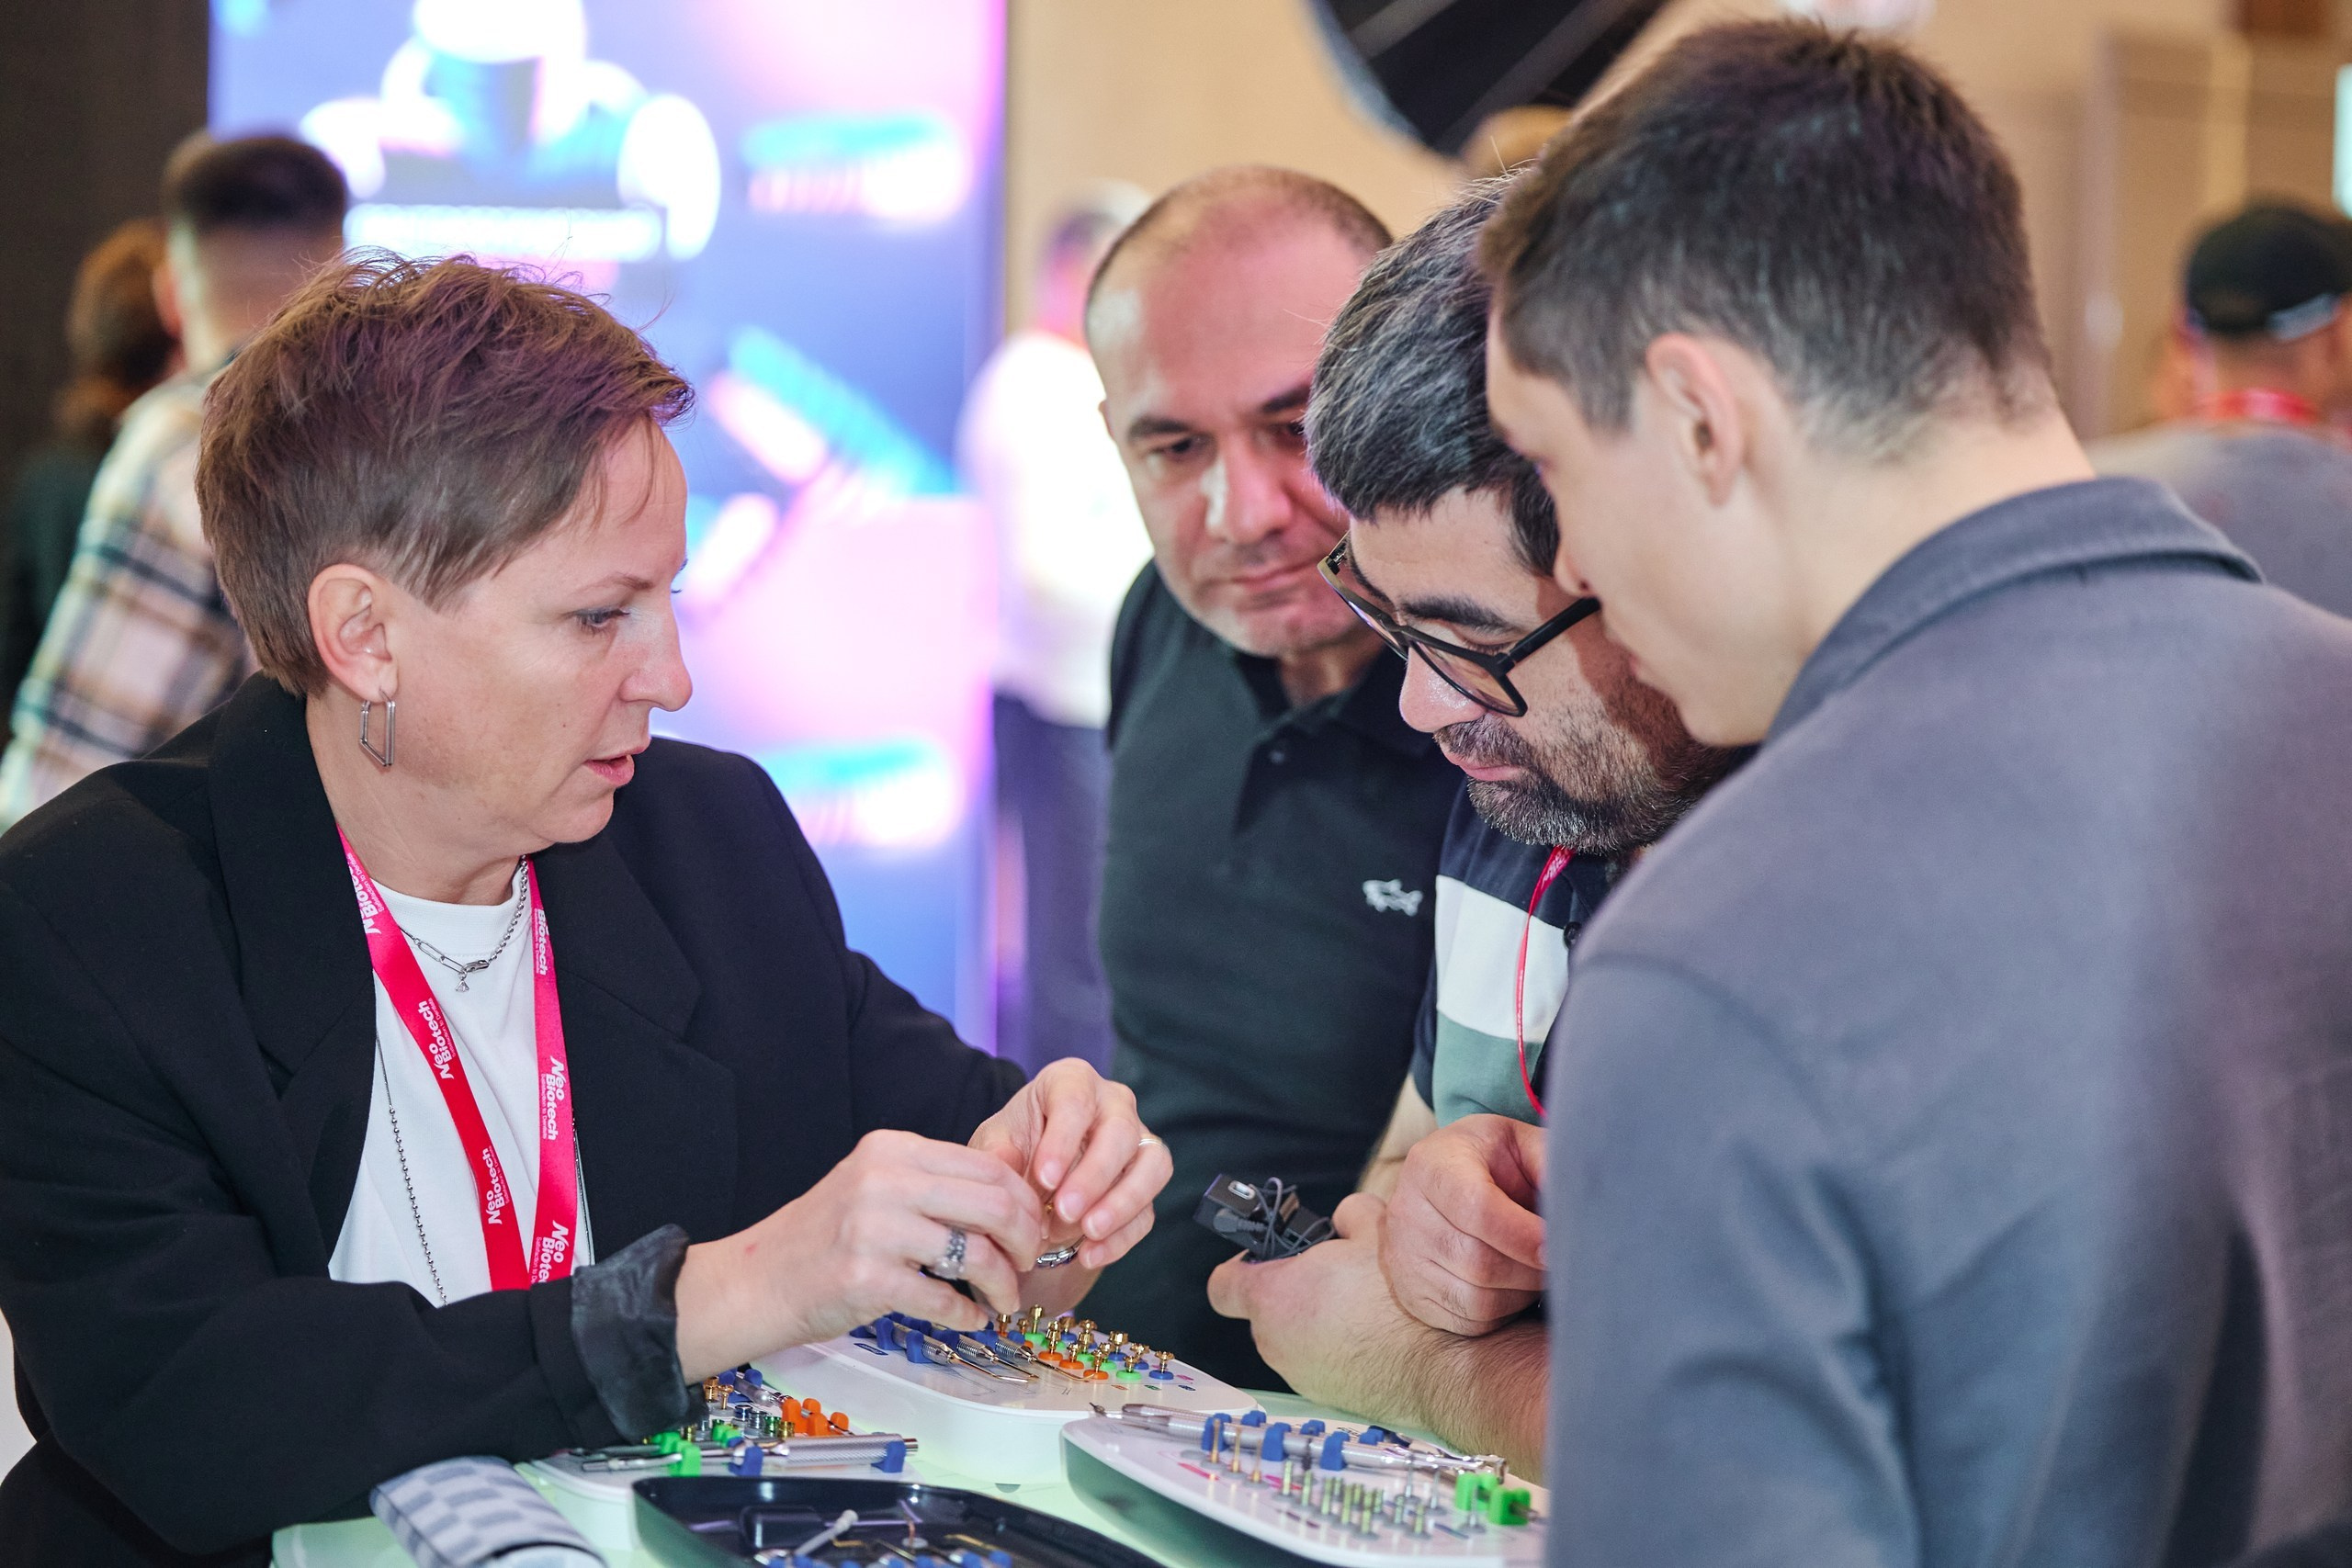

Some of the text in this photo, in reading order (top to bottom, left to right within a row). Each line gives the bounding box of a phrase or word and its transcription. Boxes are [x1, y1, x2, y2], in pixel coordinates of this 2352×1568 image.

[349, 865, 379, 918] Biote
[538, 908, 548, 976] Biotech
[418, 1000, 452, 1063] Biotech
[429, 1043, 454, 1079] Neo
[549, 1055, 566, 1101] Neo
[546, 1073, 559, 1140] Biotech
[482, 1147, 505, 1209] Biotech
[485, 1190, 503, 1225] Neo
[538, 1236, 556, 1283] Biote
[552, 1219, 570, 1263] Neo
